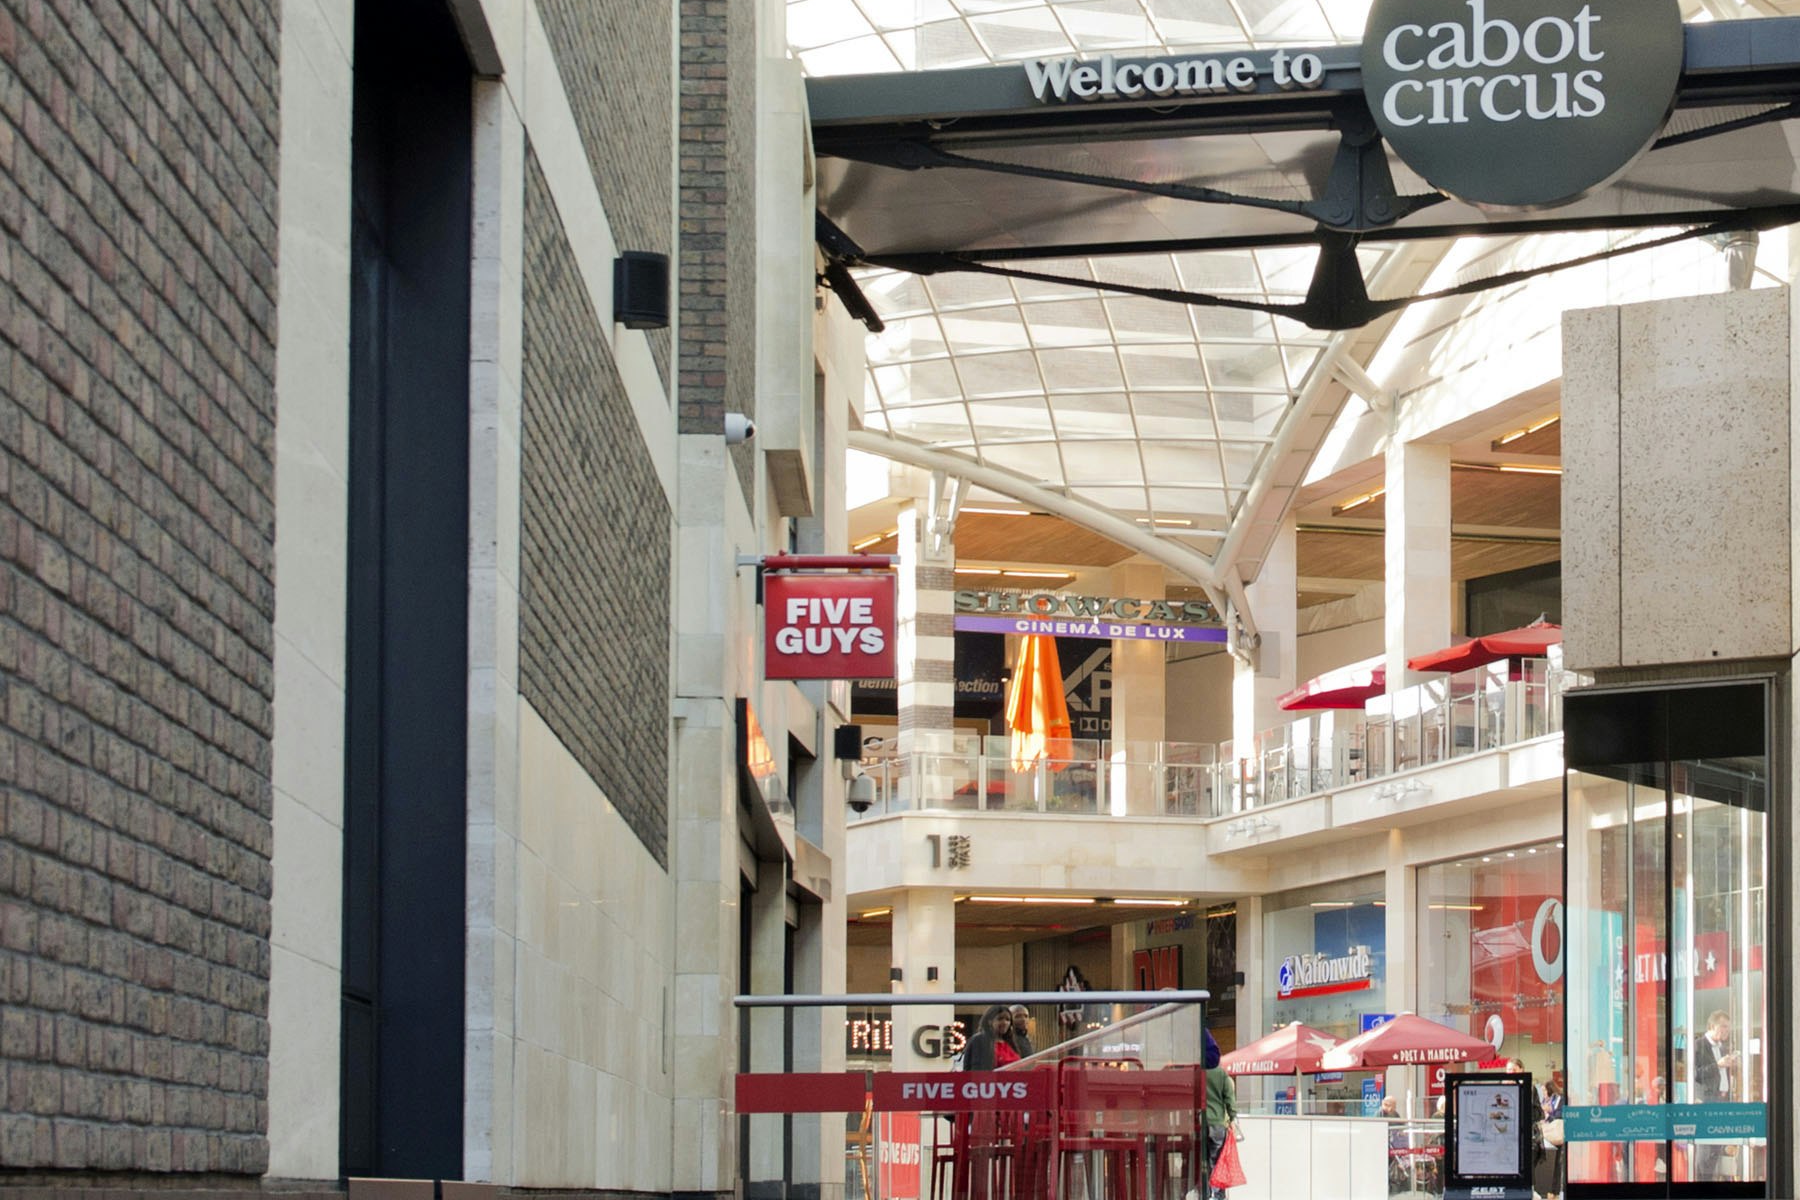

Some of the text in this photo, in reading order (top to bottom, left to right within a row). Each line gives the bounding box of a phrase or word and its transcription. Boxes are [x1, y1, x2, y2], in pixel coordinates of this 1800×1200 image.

[1024, 49, 1323, 101] Welcome to
[1383, 68, 1605, 126] circus
[786, 597, 874, 625] FIVE
[955, 590, 1223, 622] SHOWCAS
[775, 626, 885, 654] GUYS
[1015, 620, 1185, 640] CINEMA DE LUX
[926, 834, 941, 868] 1
[1294, 951, 1370, 986] Nationwide
[1400, 1048, 1460, 1062] PRET A MANGER
[903, 1082, 1028, 1099] FIVE GUYS
